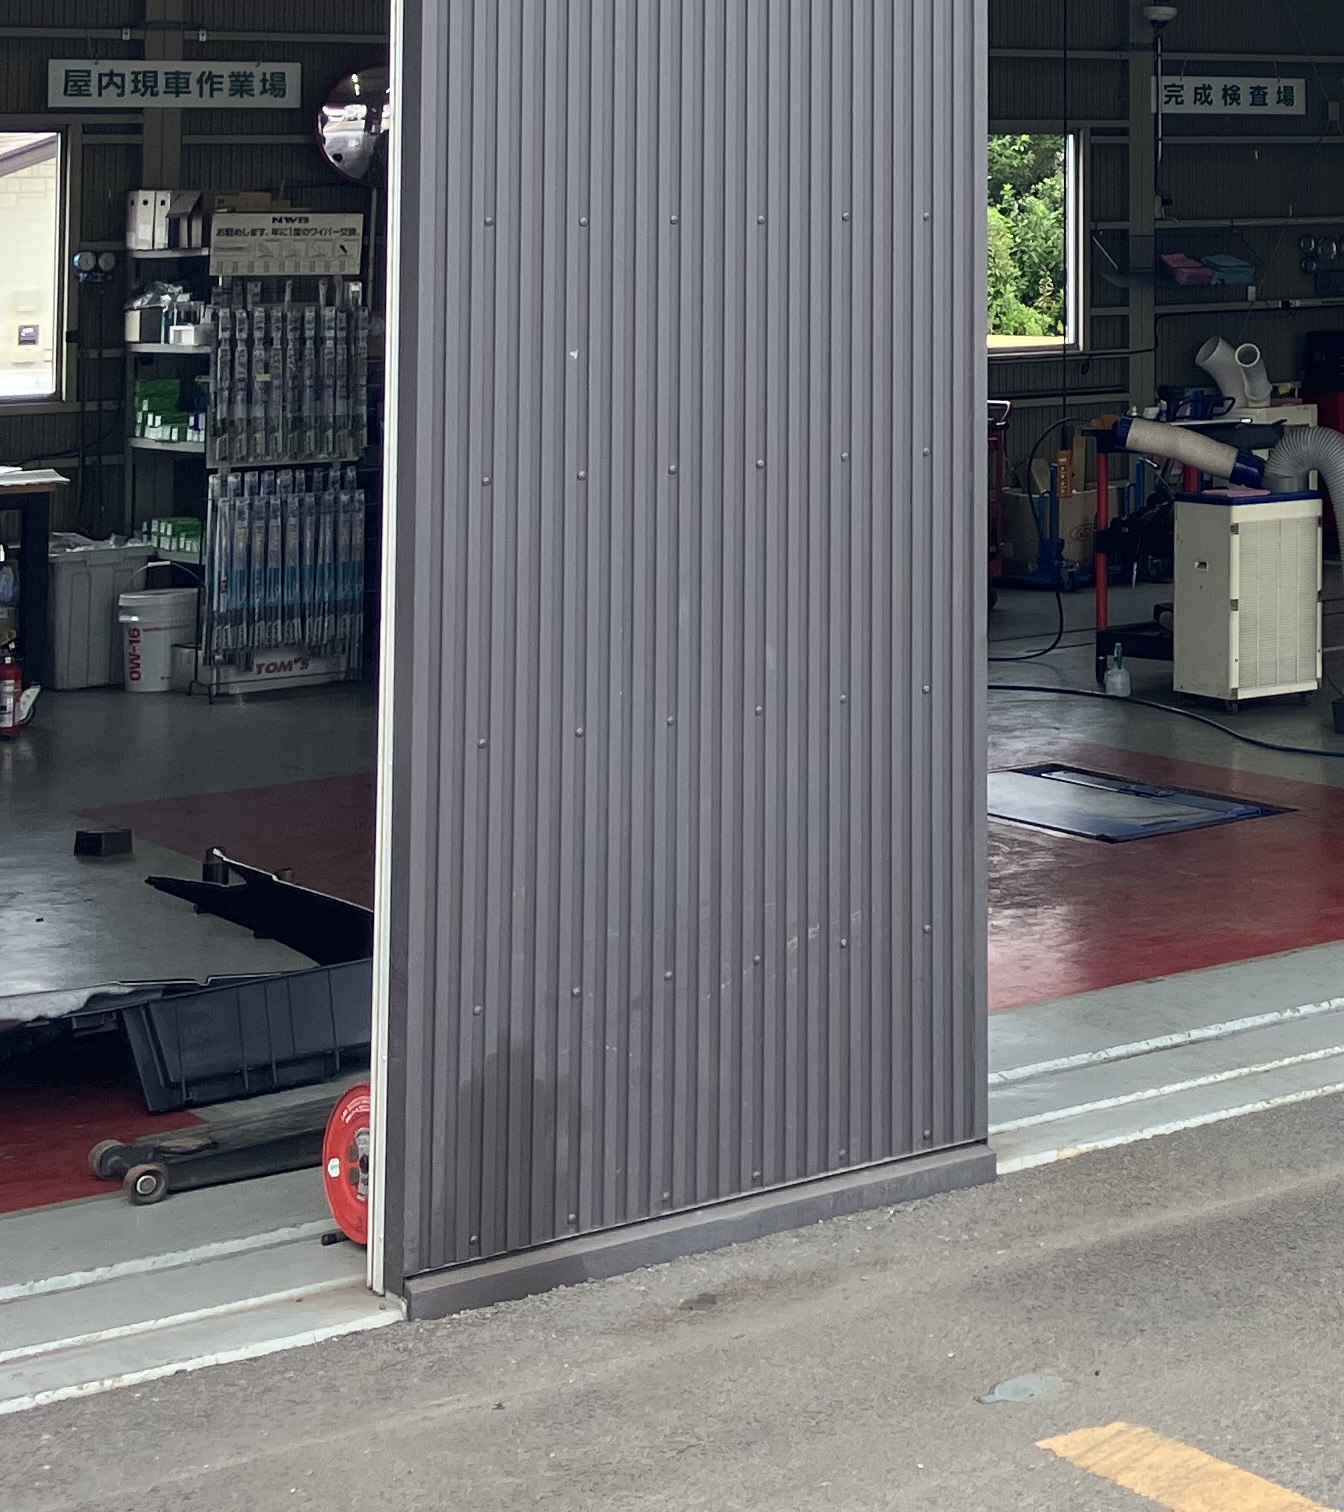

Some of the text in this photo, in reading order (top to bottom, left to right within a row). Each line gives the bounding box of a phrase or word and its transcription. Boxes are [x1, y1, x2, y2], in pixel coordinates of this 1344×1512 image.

[63, 69, 286, 98] 屋内現車作業場
[1163, 83, 1295, 106] 完成検査場
